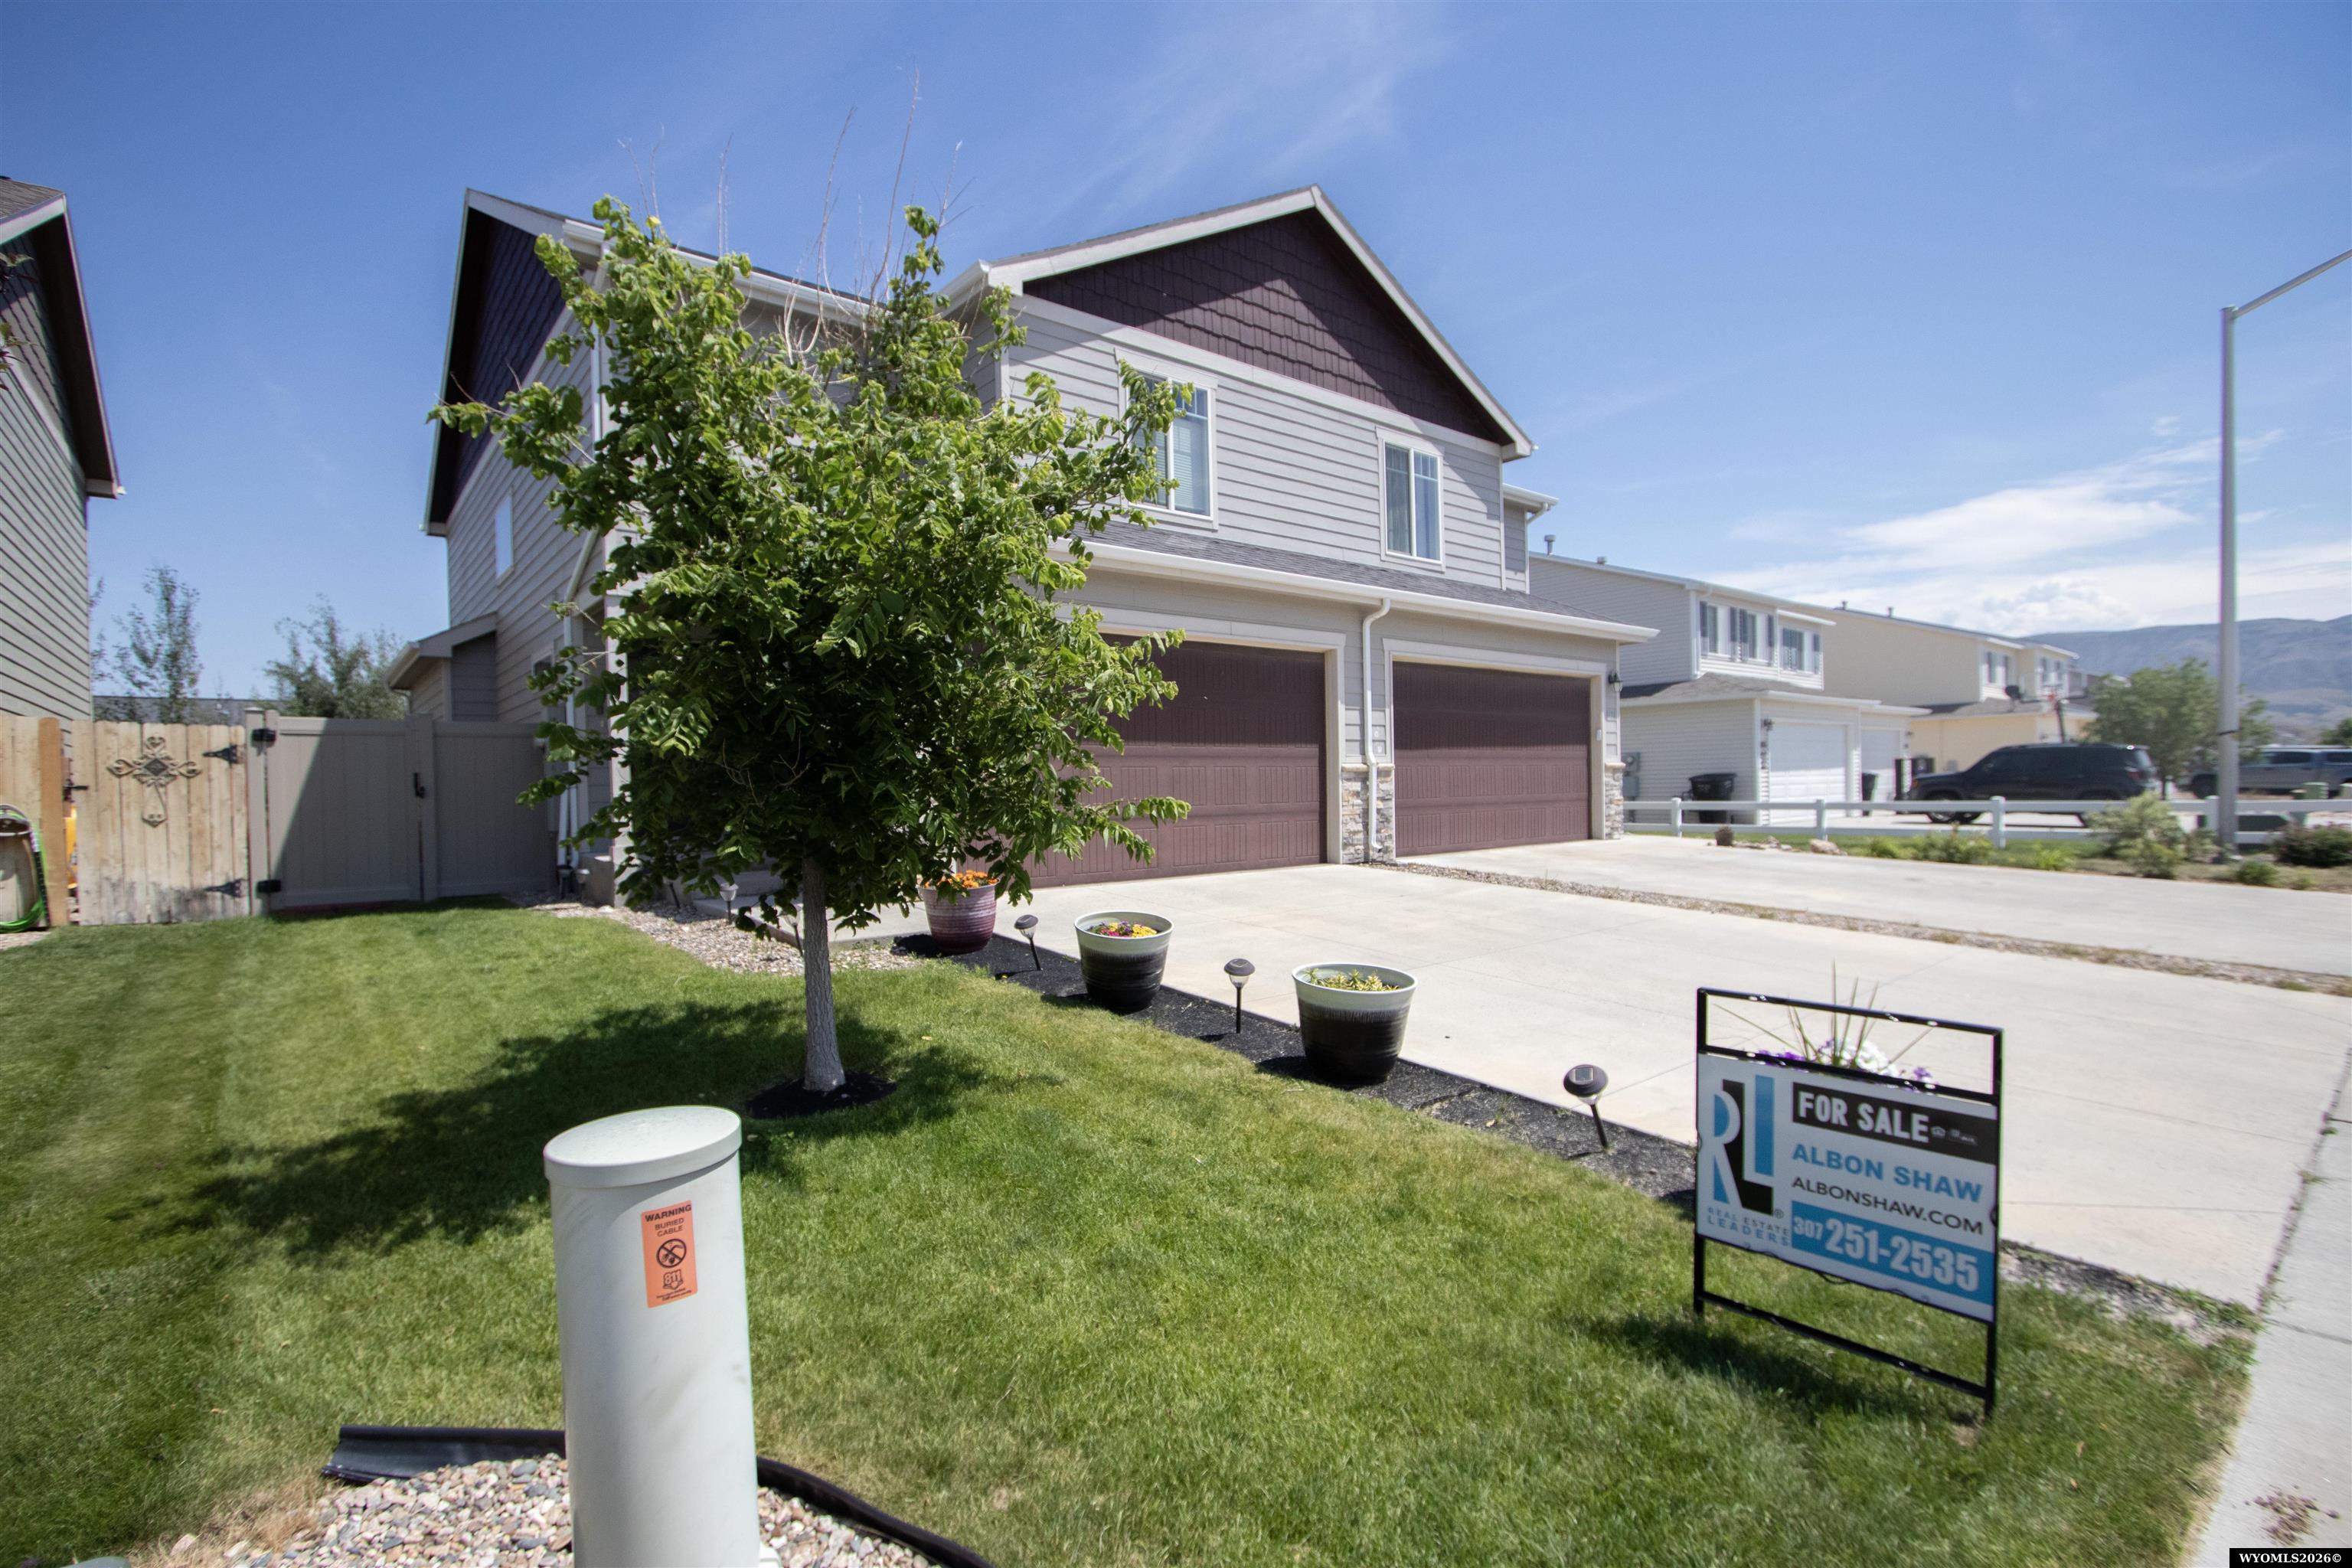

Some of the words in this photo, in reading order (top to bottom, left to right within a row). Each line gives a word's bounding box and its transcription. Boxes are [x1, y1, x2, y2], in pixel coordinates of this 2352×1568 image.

[1798, 1090, 1848, 1127] FOR
[1857, 1102, 1929, 1143] SALE
[1792, 1144, 1883, 1181] ALBON
[1893, 1165, 1983, 1203] SHAW
[645, 1204, 692, 1223] WARNING
[1792, 1177, 1984, 1235] ALBONSHAW.COM
[655, 1217, 684, 1231] BURIED
[657, 1225, 684, 1238] CABLE
[1707, 1215, 1788, 1246] LEADERS
[1743, 1217, 1789, 1236] ESTATE
[1793, 1216, 1824, 1241] 307
[1824, 1218, 1979, 1292] 251-2535
[663, 1269, 682, 1286] 811
